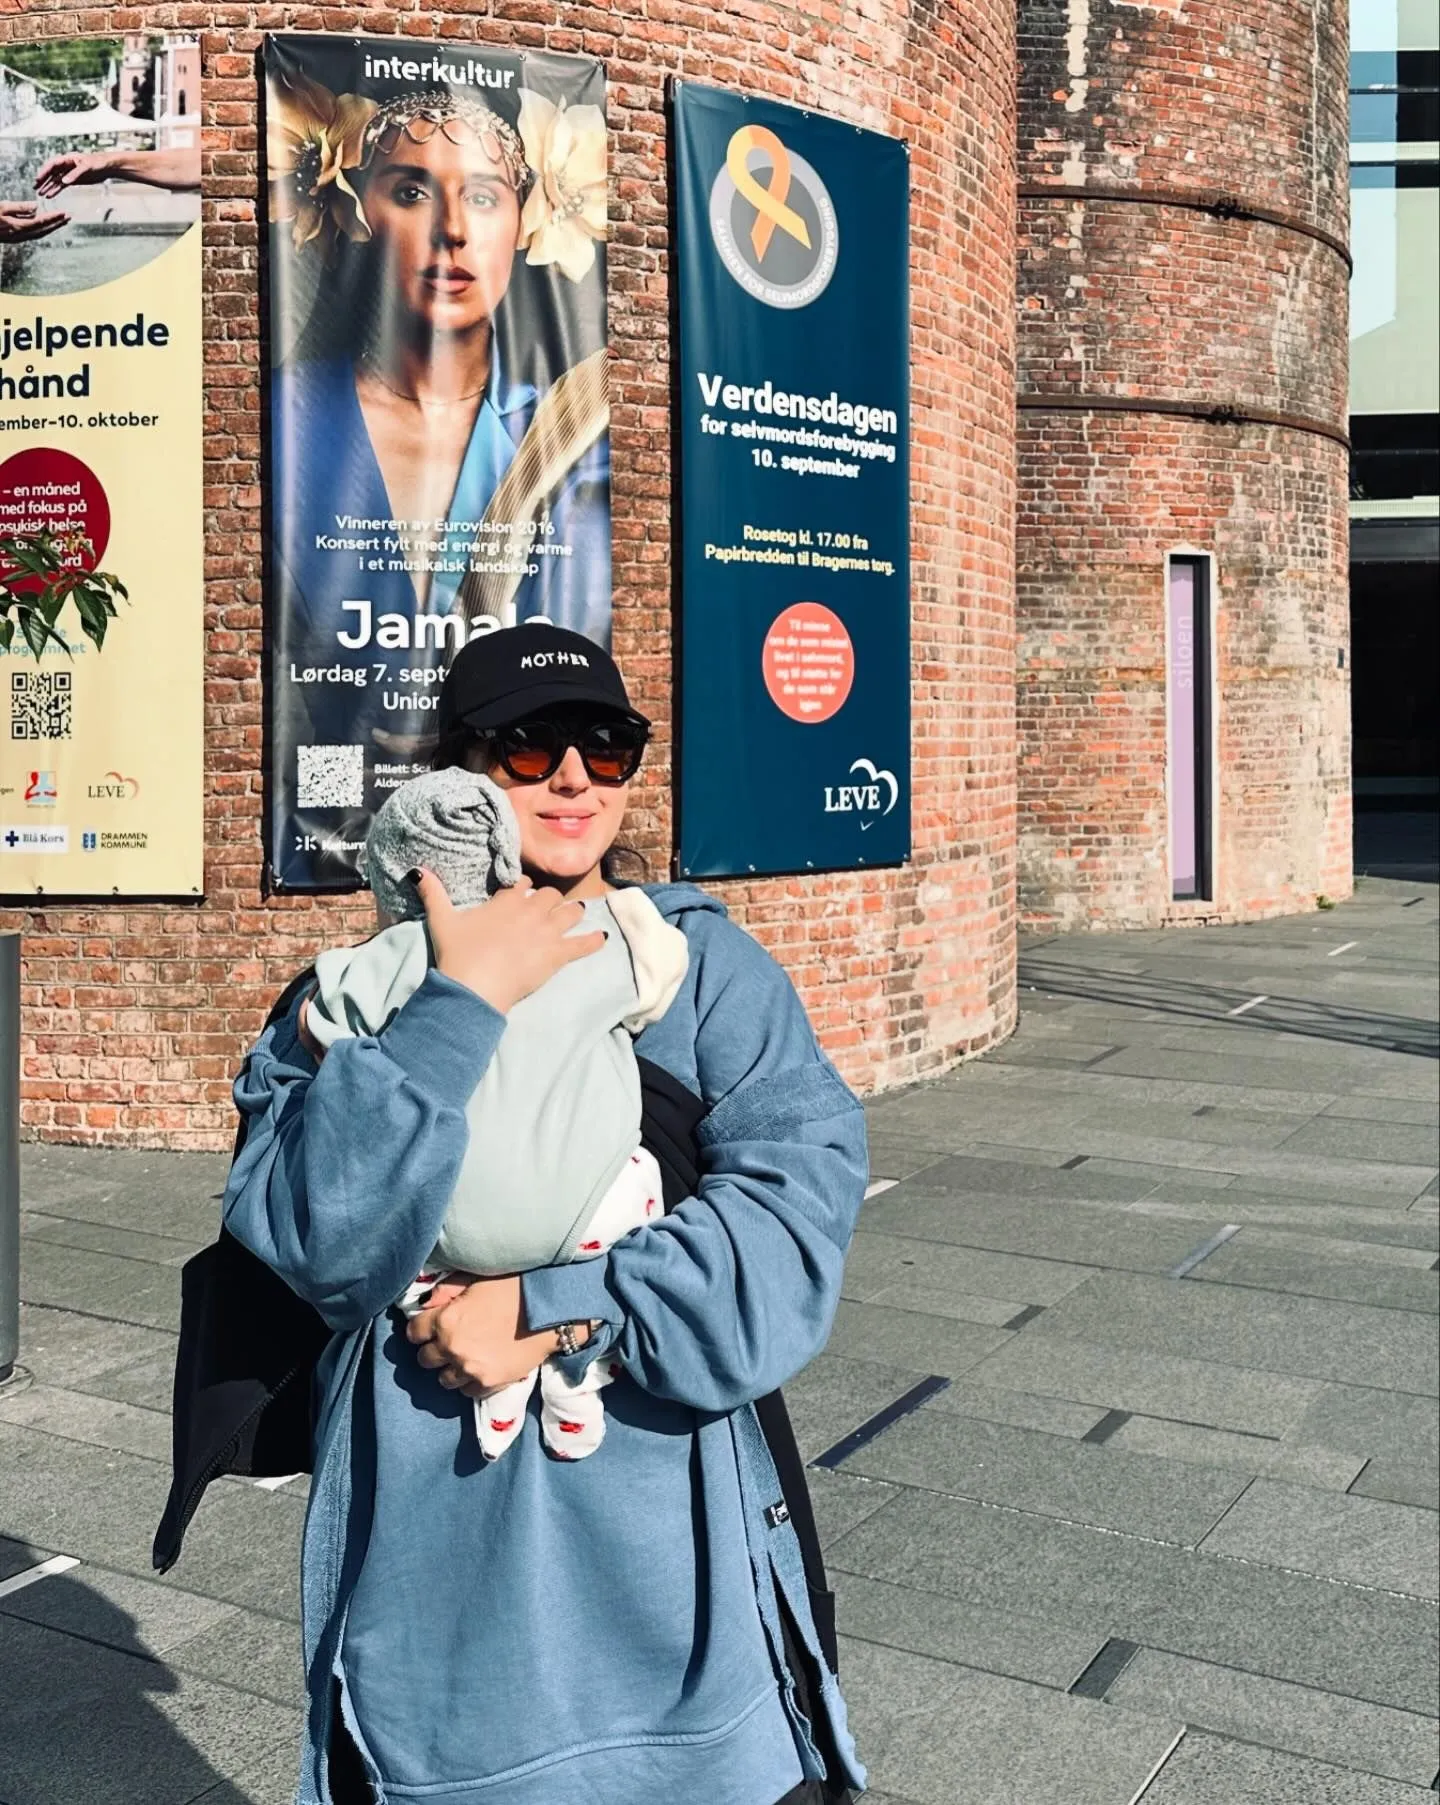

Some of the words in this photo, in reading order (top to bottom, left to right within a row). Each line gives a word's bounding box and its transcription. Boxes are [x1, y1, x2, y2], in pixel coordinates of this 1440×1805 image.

[365, 55, 514, 89] interkultur
[0, 313, 170, 360] jelpende
[0, 364, 90, 400] hånd
[697, 373, 897, 436] Verdensdagen
[88, 412, 158, 428] oktober
[700, 414, 728, 435] for
[731, 420, 896, 463] selvmordsforebygging
[752, 448, 777, 468] 10.
[781, 454, 860, 478] september
[13, 486, 29, 497] en
[32, 481, 81, 496] måned
[28, 500, 65, 514] fokus
[68, 499, 87, 516] på
[335, 515, 407, 531] Vinneren
[435, 518, 513, 533] Eurovision
[517, 520, 555, 536] 2016
[743, 525, 796, 547] Rosetog
[800, 529, 813, 546] kl.
[817, 532, 850, 549] 17.00
[852, 534, 868, 550] fra
[316, 535, 380, 551] Konsert
[383, 537, 410, 554] fylt
[414, 539, 448, 552] med
[452, 540, 500, 556] energi
[528, 543, 573, 556] varme
[359, 556, 365, 571] i
[367, 557, 385, 571] et
[388, 557, 466, 572] musikalsk
[470, 559, 539, 577] landskap
[705, 544, 794, 564] Papirbredden
[797, 551, 809, 566] til
[812, 552, 869, 572] Bragernes
[871, 558, 895, 576] torg.
[521, 651, 590, 669] MOTHER
[1173, 616, 1192, 689] siloen
[291, 664, 367, 687] Lørdag
[372, 663, 393, 683] 7.
[399, 665, 450, 687] sept
[88, 785, 125, 798] LEVE
[824, 786, 880, 812] LEVE
[101, 832, 148, 841] DRAMMEN
[101, 841, 147, 849] KOMMUNE
